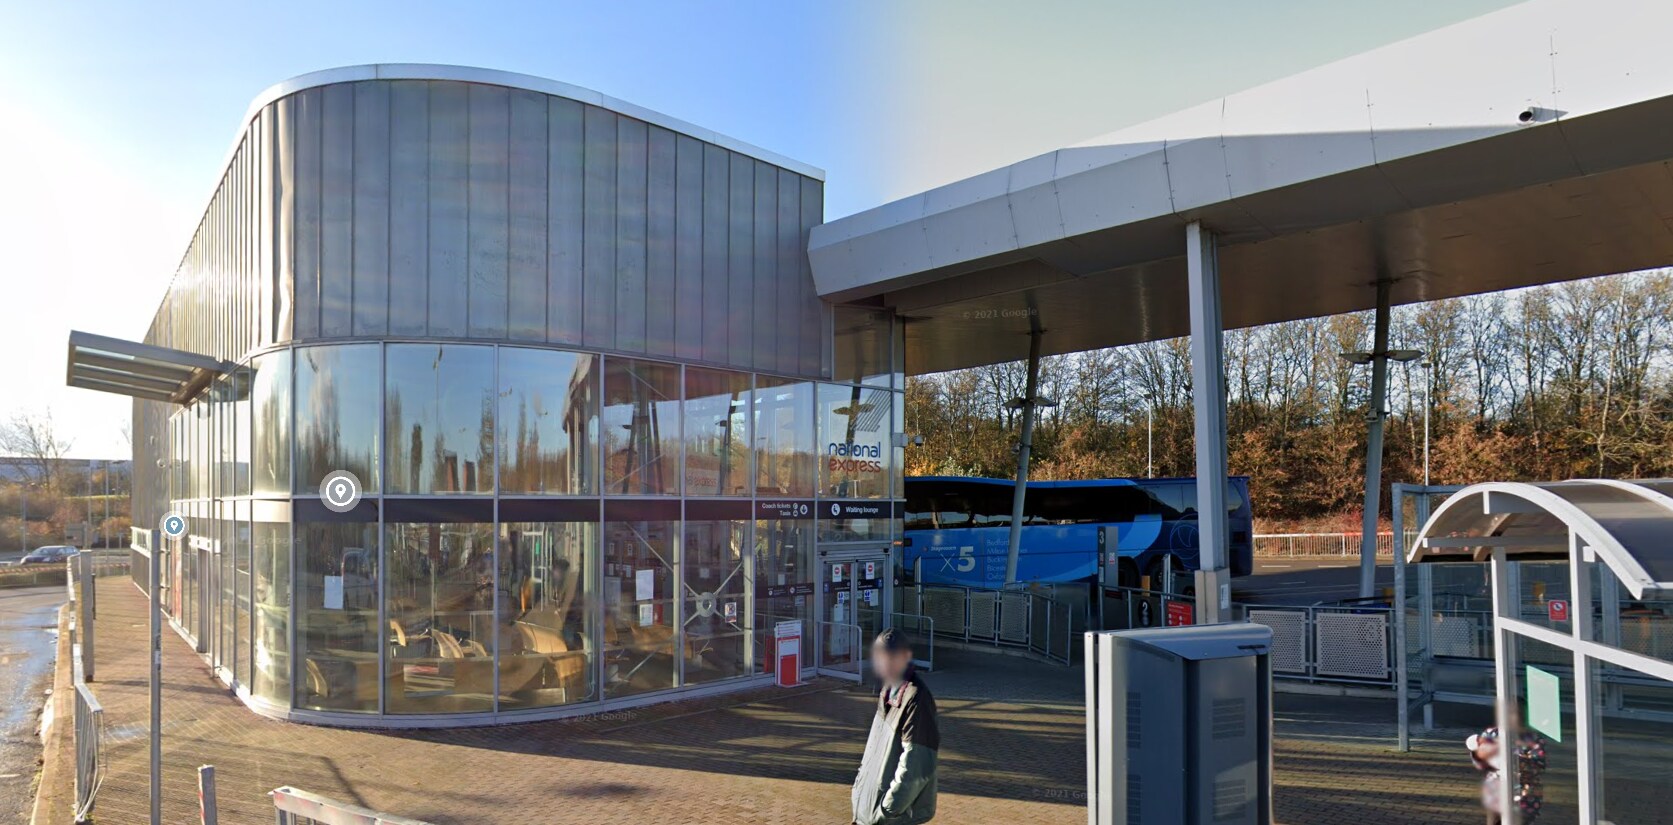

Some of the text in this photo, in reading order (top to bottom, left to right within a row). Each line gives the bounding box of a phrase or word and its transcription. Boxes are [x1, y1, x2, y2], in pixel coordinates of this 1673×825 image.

[828, 441, 881, 458] national
[829, 459, 881, 475] express
[845, 506, 879, 514] Waiting lounge
[1099, 531, 1105, 544] 3
[940, 546, 976, 572] X5
[1142, 602, 1148, 612] 2
